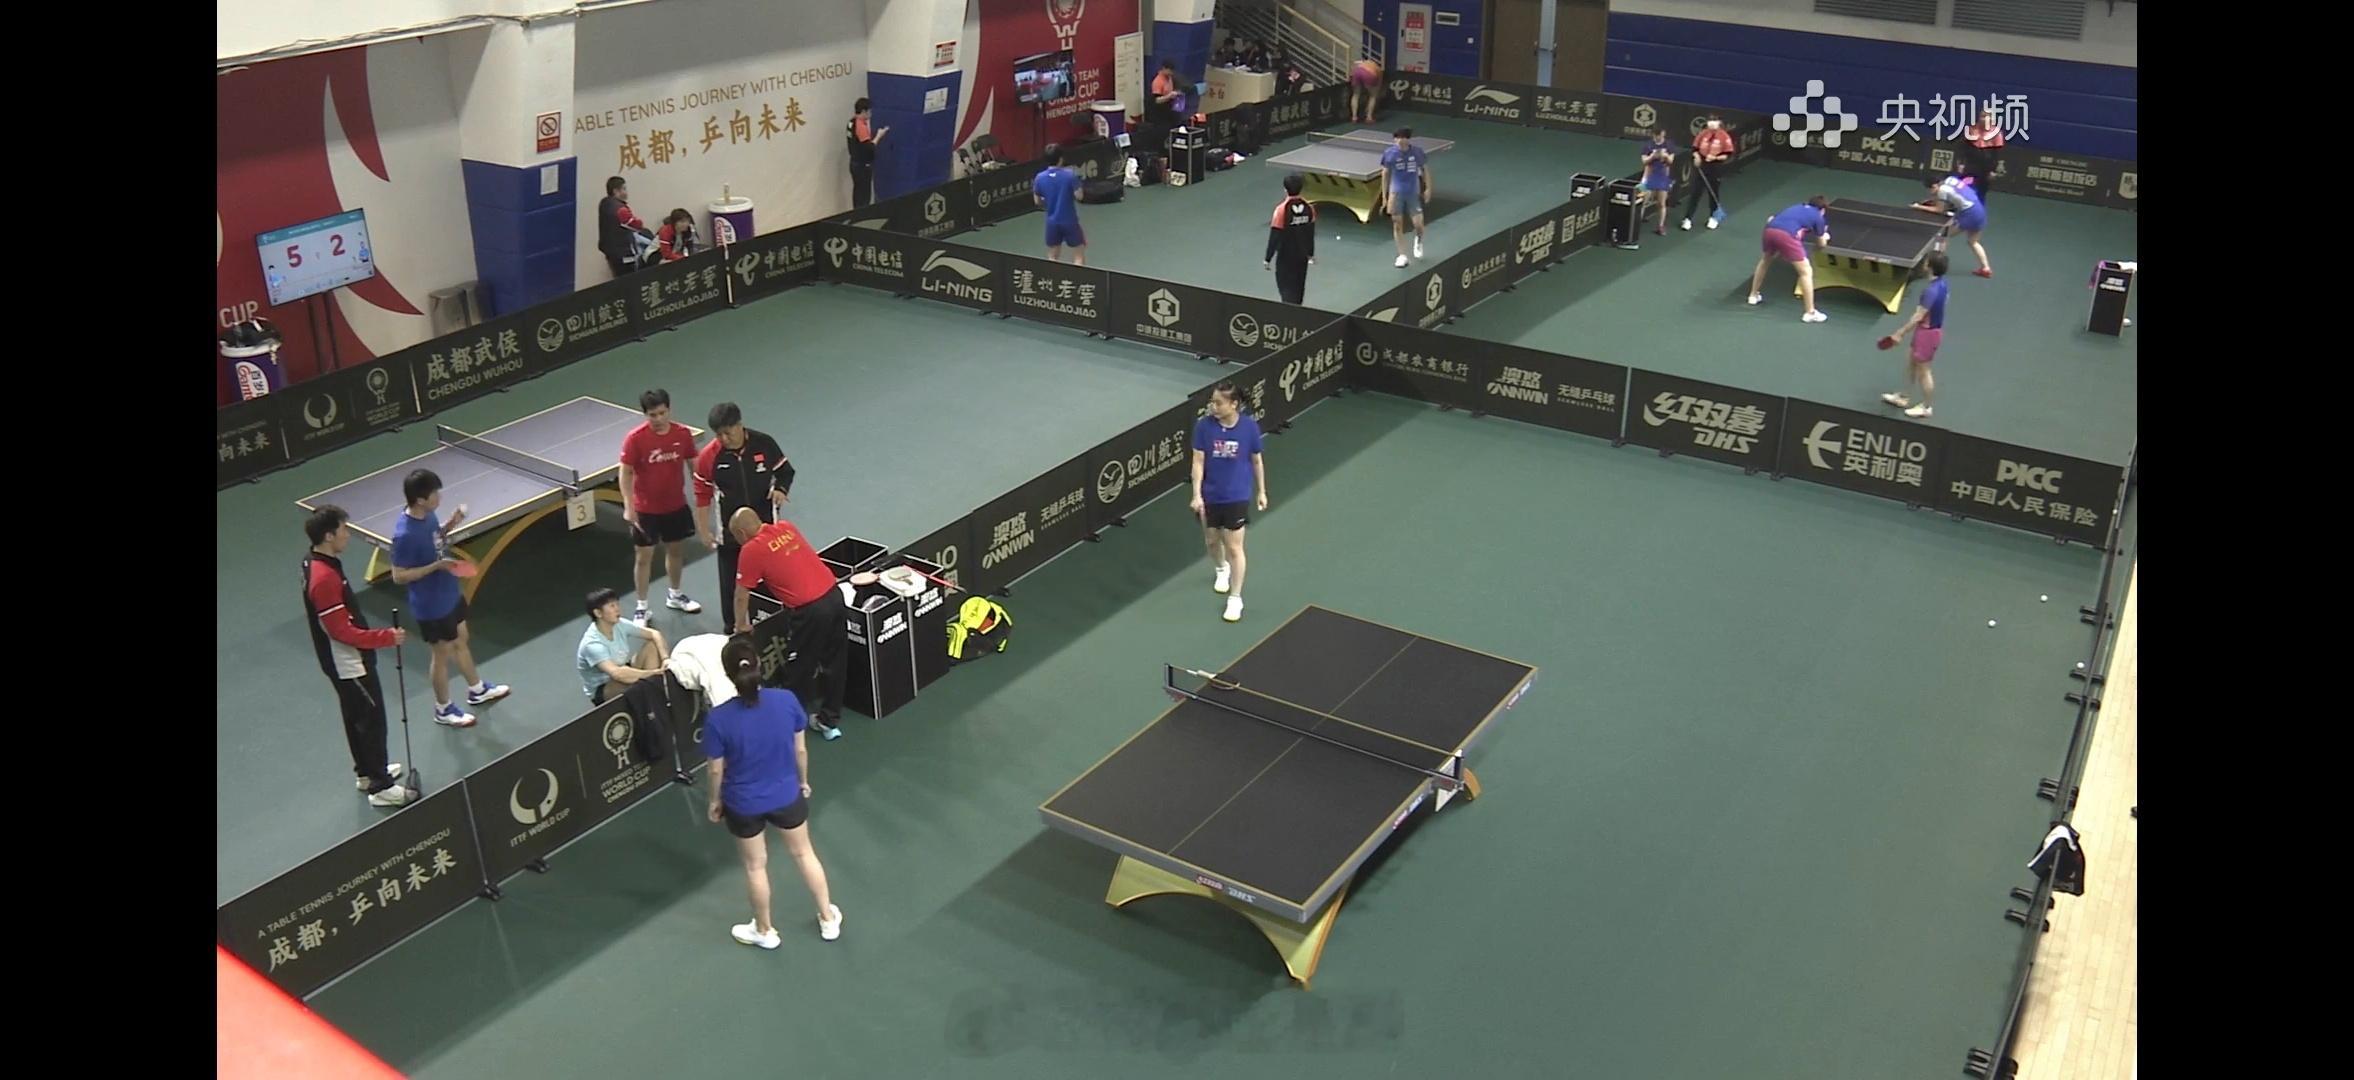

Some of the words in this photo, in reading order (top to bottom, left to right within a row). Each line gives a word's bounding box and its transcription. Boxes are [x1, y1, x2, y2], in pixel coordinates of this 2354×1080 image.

[618, 98, 675, 124] TENNIS
[679, 82, 747, 112] JOURNEY
[749, 73, 787, 95] WITH
[789, 61, 853, 87] CHENGDU
[1078, 81, 1100, 98] CUP
[1464, 104, 1520, 119] LI-NING
[287, 245, 302, 268] 5
[330, 234, 346, 256] 2
[764, 239, 814, 270] 中国电信
[852, 242, 903, 268] 中国电信
[921, 277, 993, 303] LI-NING
[1013, 268, 1097, 306] 泸州老窖
[219, 300, 259, 328] CUP
[566, 298, 626, 333] 四川航空
[643, 289, 720, 321] LUZHOULAOJIAO
[1014, 294, 1097, 318] LUZHOULAOJIAO
[425, 328, 521, 385] 成都武侯
[1302, 339, 1344, 380] 中国电信
[428, 374, 481, 401] CHENGDU
[483, 357, 524, 380] WUHOU
[1558, 383, 1616, 406] 无缝乒乓球
[1643, 391, 1767, 436] 红双喜
[1127, 430, 1185, 476] 四川航空
[1692, 426, 1759, 454] DHS
[1847, 428, 1927, 462] ENLIO
[1842, 450, 1924, 488] 英利奥
[1996, 459, 2063, 494] PICC
[576, 505, 588, 522] 3
[1950, 480, 2099, 527] 中国人民保险
[602, 776, 633, 798] WORLD
[634, 765, 651, 779] CUP
[510, 830, 528, 847] ITTF
[528, 816, 555, 837] WORLD
[556, 808, 571, 823] CUP
[258, 929, 266, 939] A
[267, 911, 298, 933] TABLE
[299, 892, 334, 916] TENNIS
[335, 866, 380, 898] JOURNEY
[380, 854, 404, 871] WITH
[405, 828, 451, 857] CHENGDU
